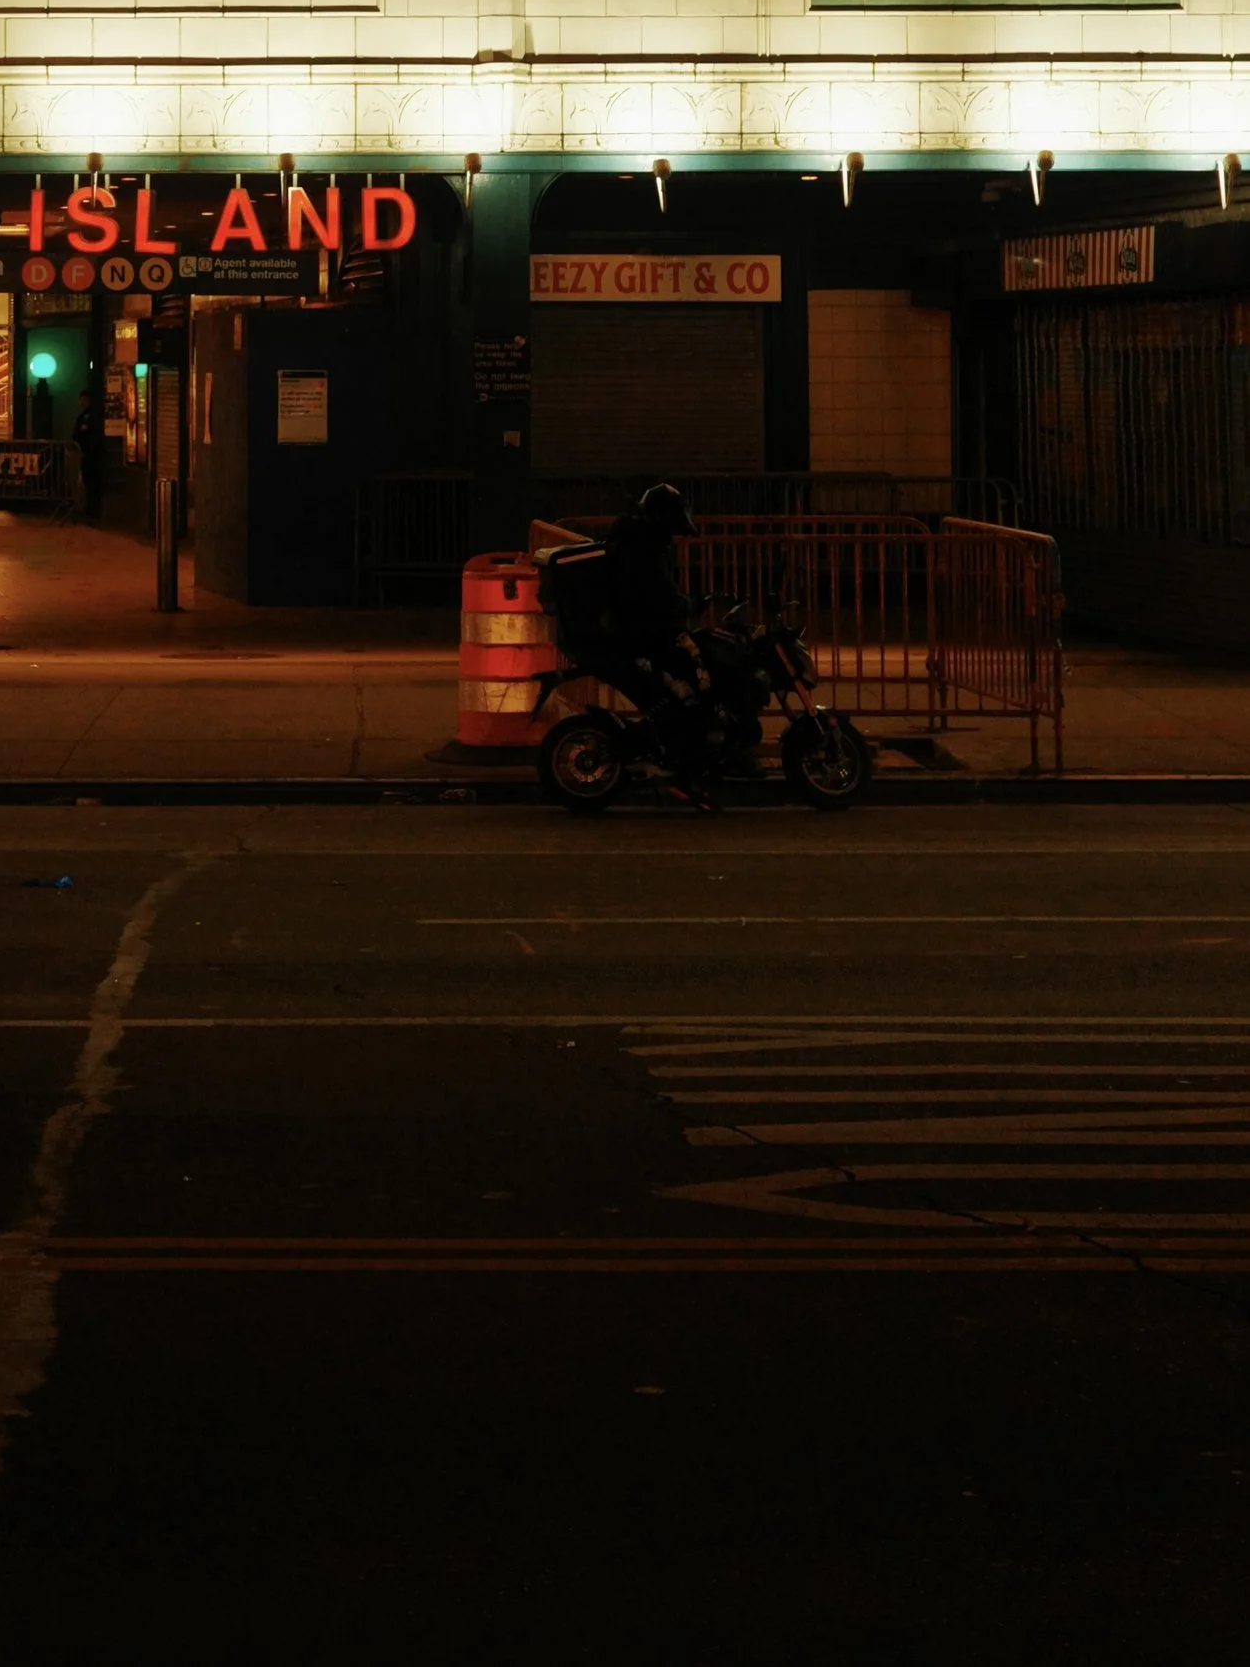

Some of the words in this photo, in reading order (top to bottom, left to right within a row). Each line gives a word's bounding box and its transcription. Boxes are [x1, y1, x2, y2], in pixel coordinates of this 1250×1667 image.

[28, 186, 418, 255] ISLAND
[214, 258, 247, 269] Agent
[250, 258, 297, 268] available
[214, 270, 225, 279] at
[228, 270, 248, 279] this
[251, 270, 300, 280] entrance
[614, 261, 685, 294] GIFT
[693, 261, 718, 294] &
[726, 262, 770, 294] CO
